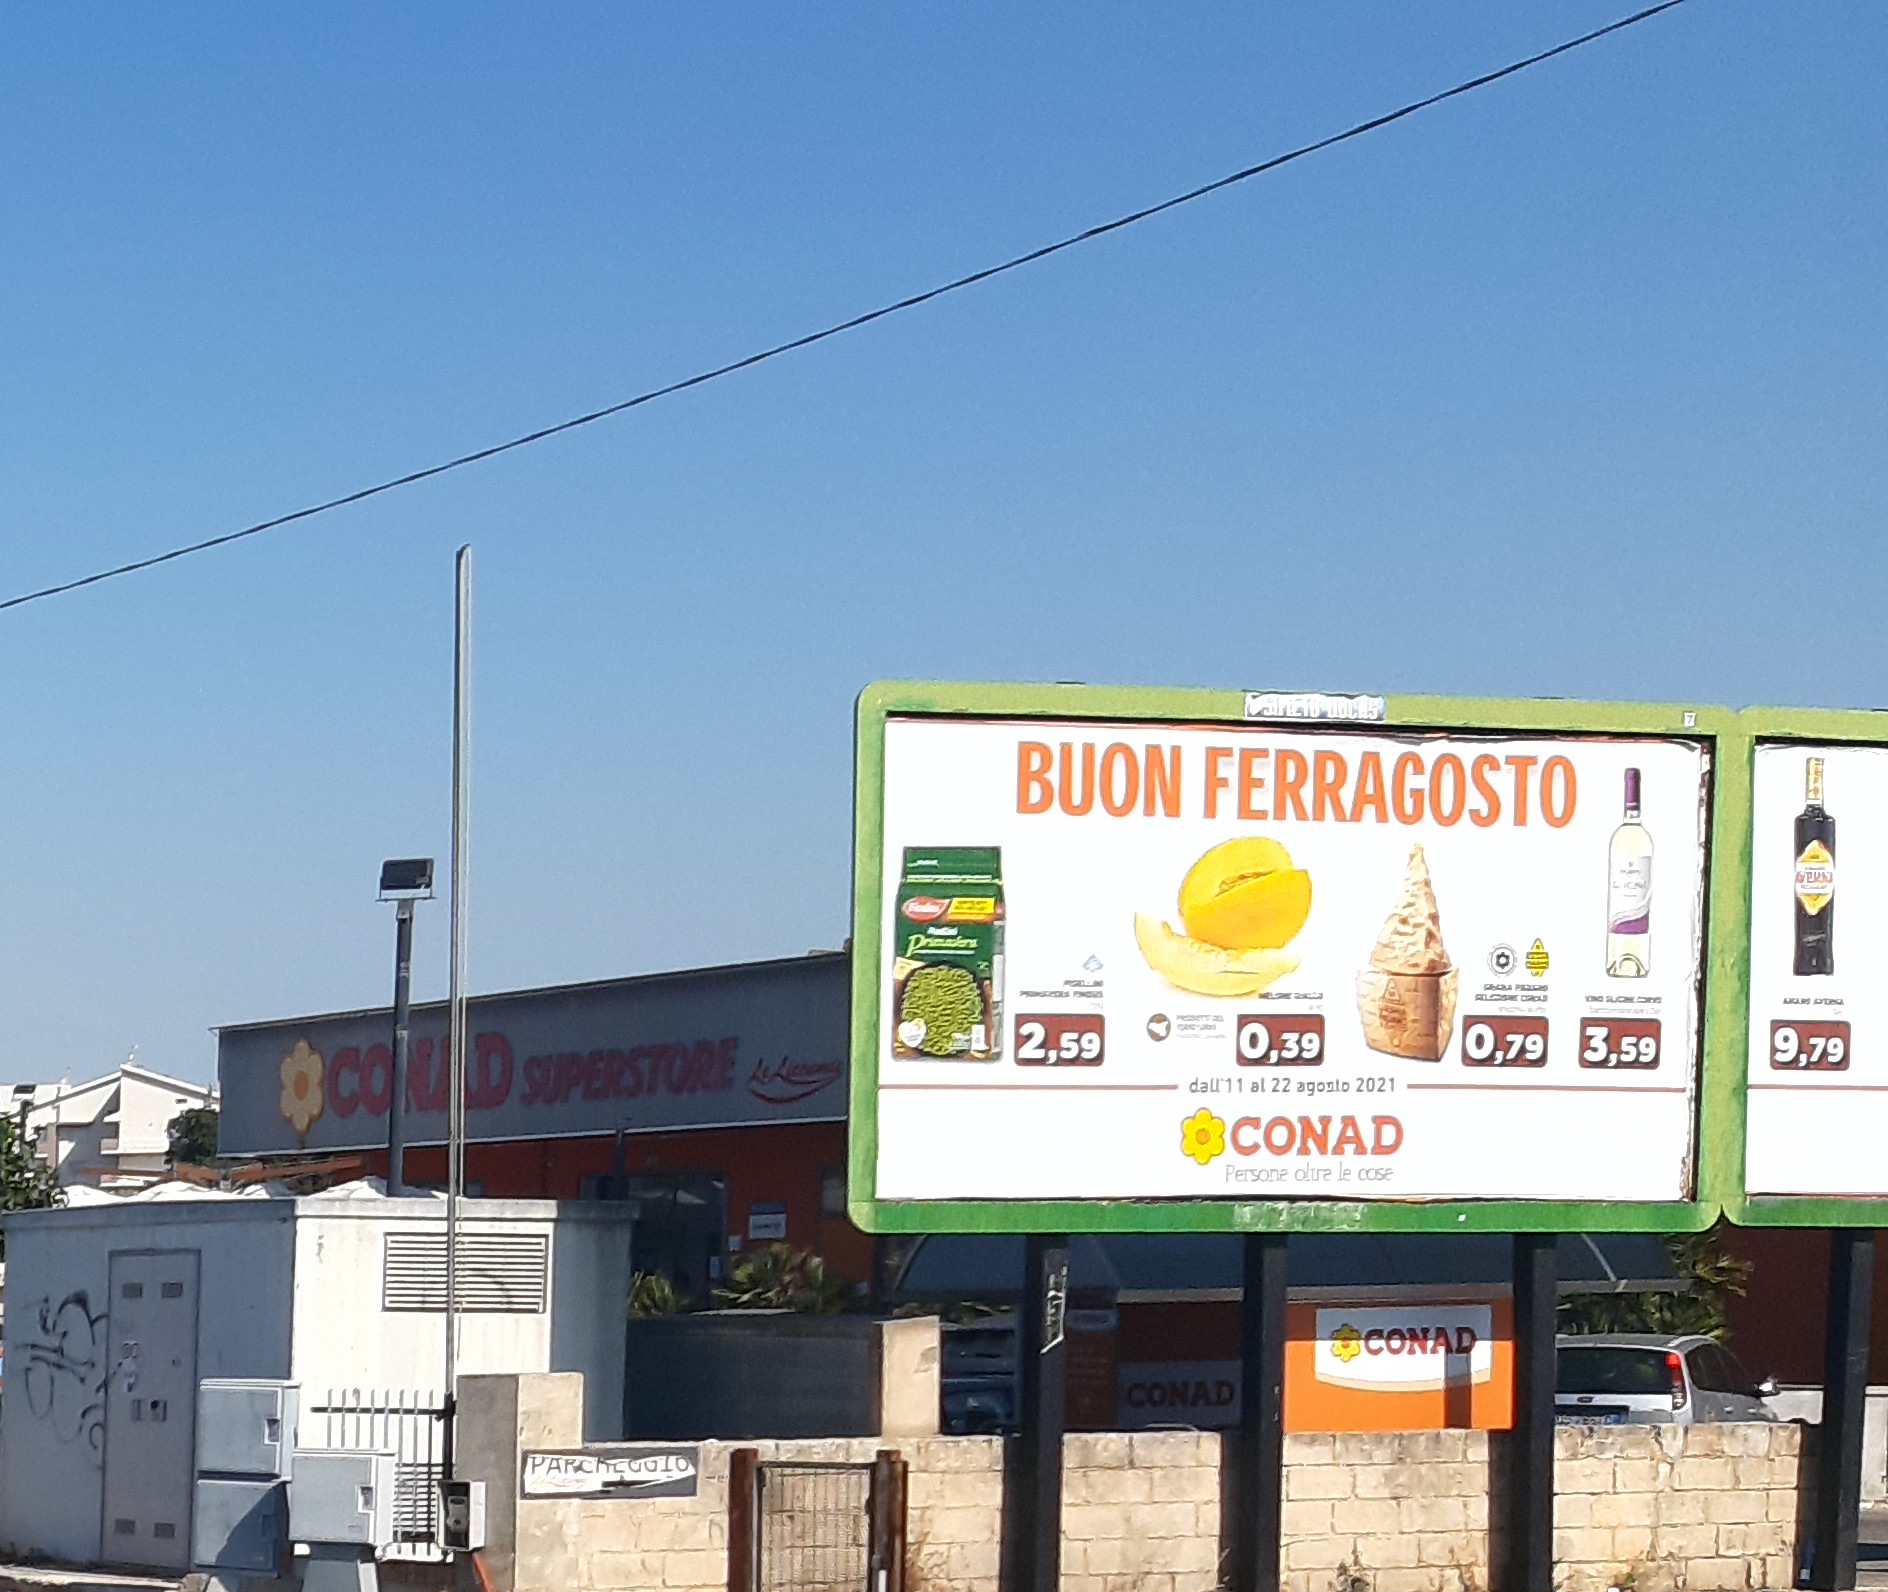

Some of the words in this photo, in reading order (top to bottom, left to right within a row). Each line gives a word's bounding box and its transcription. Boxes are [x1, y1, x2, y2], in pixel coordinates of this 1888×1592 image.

[1016, 741, 1182, 818] BUON
[1203, 746, 1578, 829] FERRAGOSTO
[1018, 1021, 1101, 1065] 2,59
[1239, 1022, 1320, 1064] 0,39
[1465, 1023, 1545, 1065] 0,79
[1583, 1026, 1657, 1067] 3,59
[1773, 1027, 1844, 1067] 9,79
[521, 1036, 740, 1106] SUPERSTORE
[1250, 1077, 1266, 1093] al
[1271, 1077, 1291, 1093] 22
[1296, 1079, 1350, 1096] agosto
[1355, 1077, 1396, 1093] 2021
[1230, 1115, 1404, 1156] CONAD
[1225, 1164, 1289, 1182] Persone
[1294, 1161, 1332, 1182] oltre
[1337, 1161, 1352, 1182] le
[1357, 1167, 1394, 1182] cose
[1364, 1326, 1477, 1356] CONAD
[1126, 1378, 1235, 1409] CONAD
